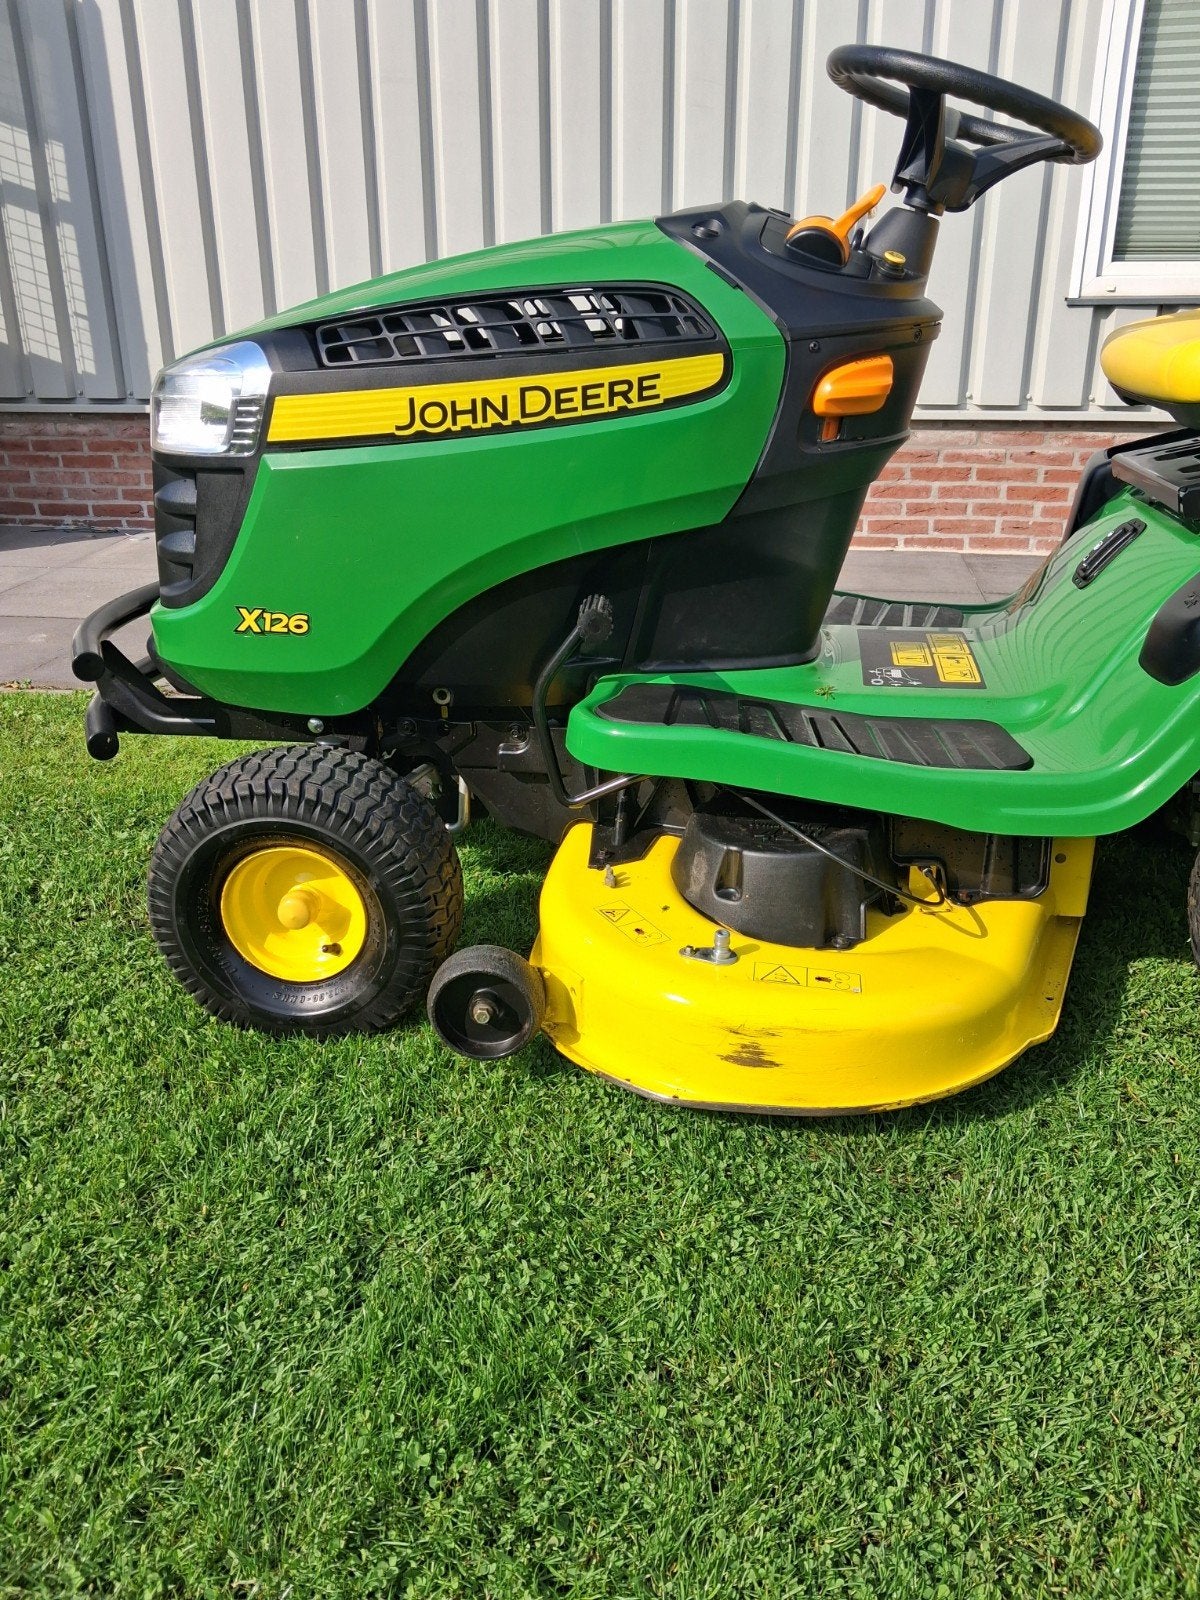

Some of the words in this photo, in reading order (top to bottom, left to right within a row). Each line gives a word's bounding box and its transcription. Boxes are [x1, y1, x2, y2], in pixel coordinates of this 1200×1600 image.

[394, 394, 509, 432] JOHN
[519, 373, 661, 419] DEERE
[234, 606, 309, 634] X126
